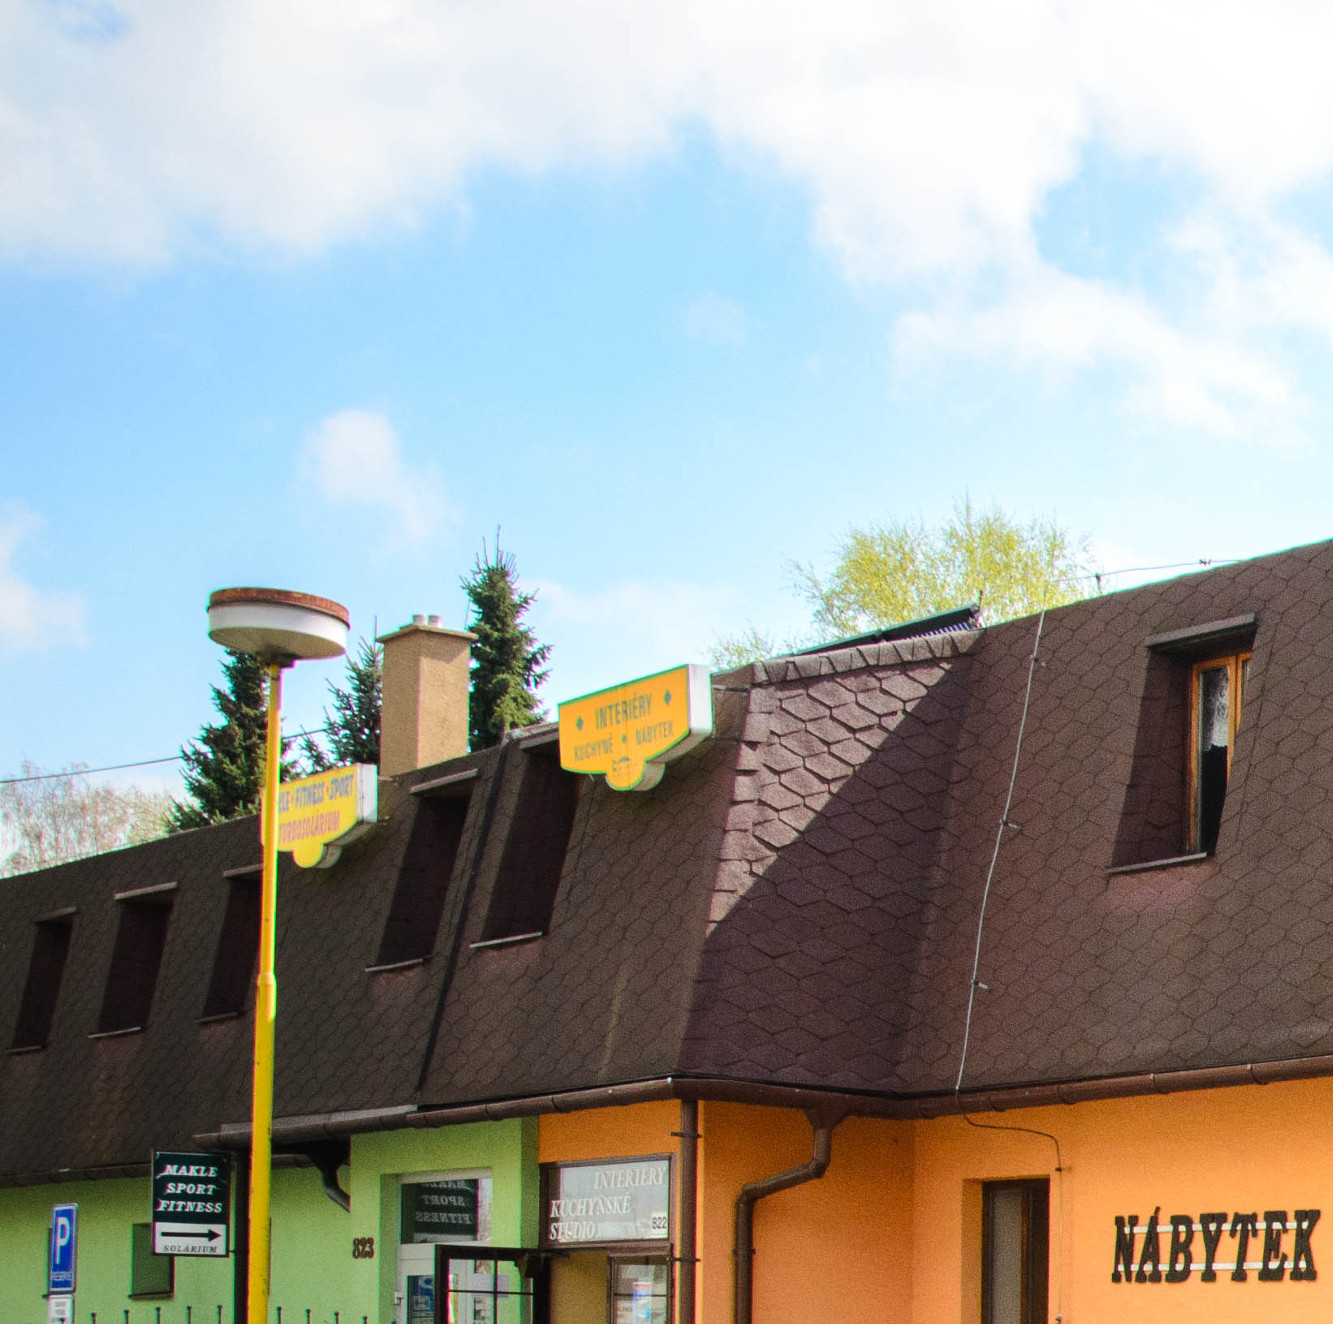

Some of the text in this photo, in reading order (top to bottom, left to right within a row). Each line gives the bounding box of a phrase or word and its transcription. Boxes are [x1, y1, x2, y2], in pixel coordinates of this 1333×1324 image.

[158, 1164, 218, 1178] MAKLE
[165, 1182, 217, 1195] SPORT
[156, 1199, 223, 1213] FITNESS
[549, 1221, 596, 1241] STUDIO
[55, 1216, 71, 1265] P
[1111, 1206, 1321, 1284] NÁBYTEK
